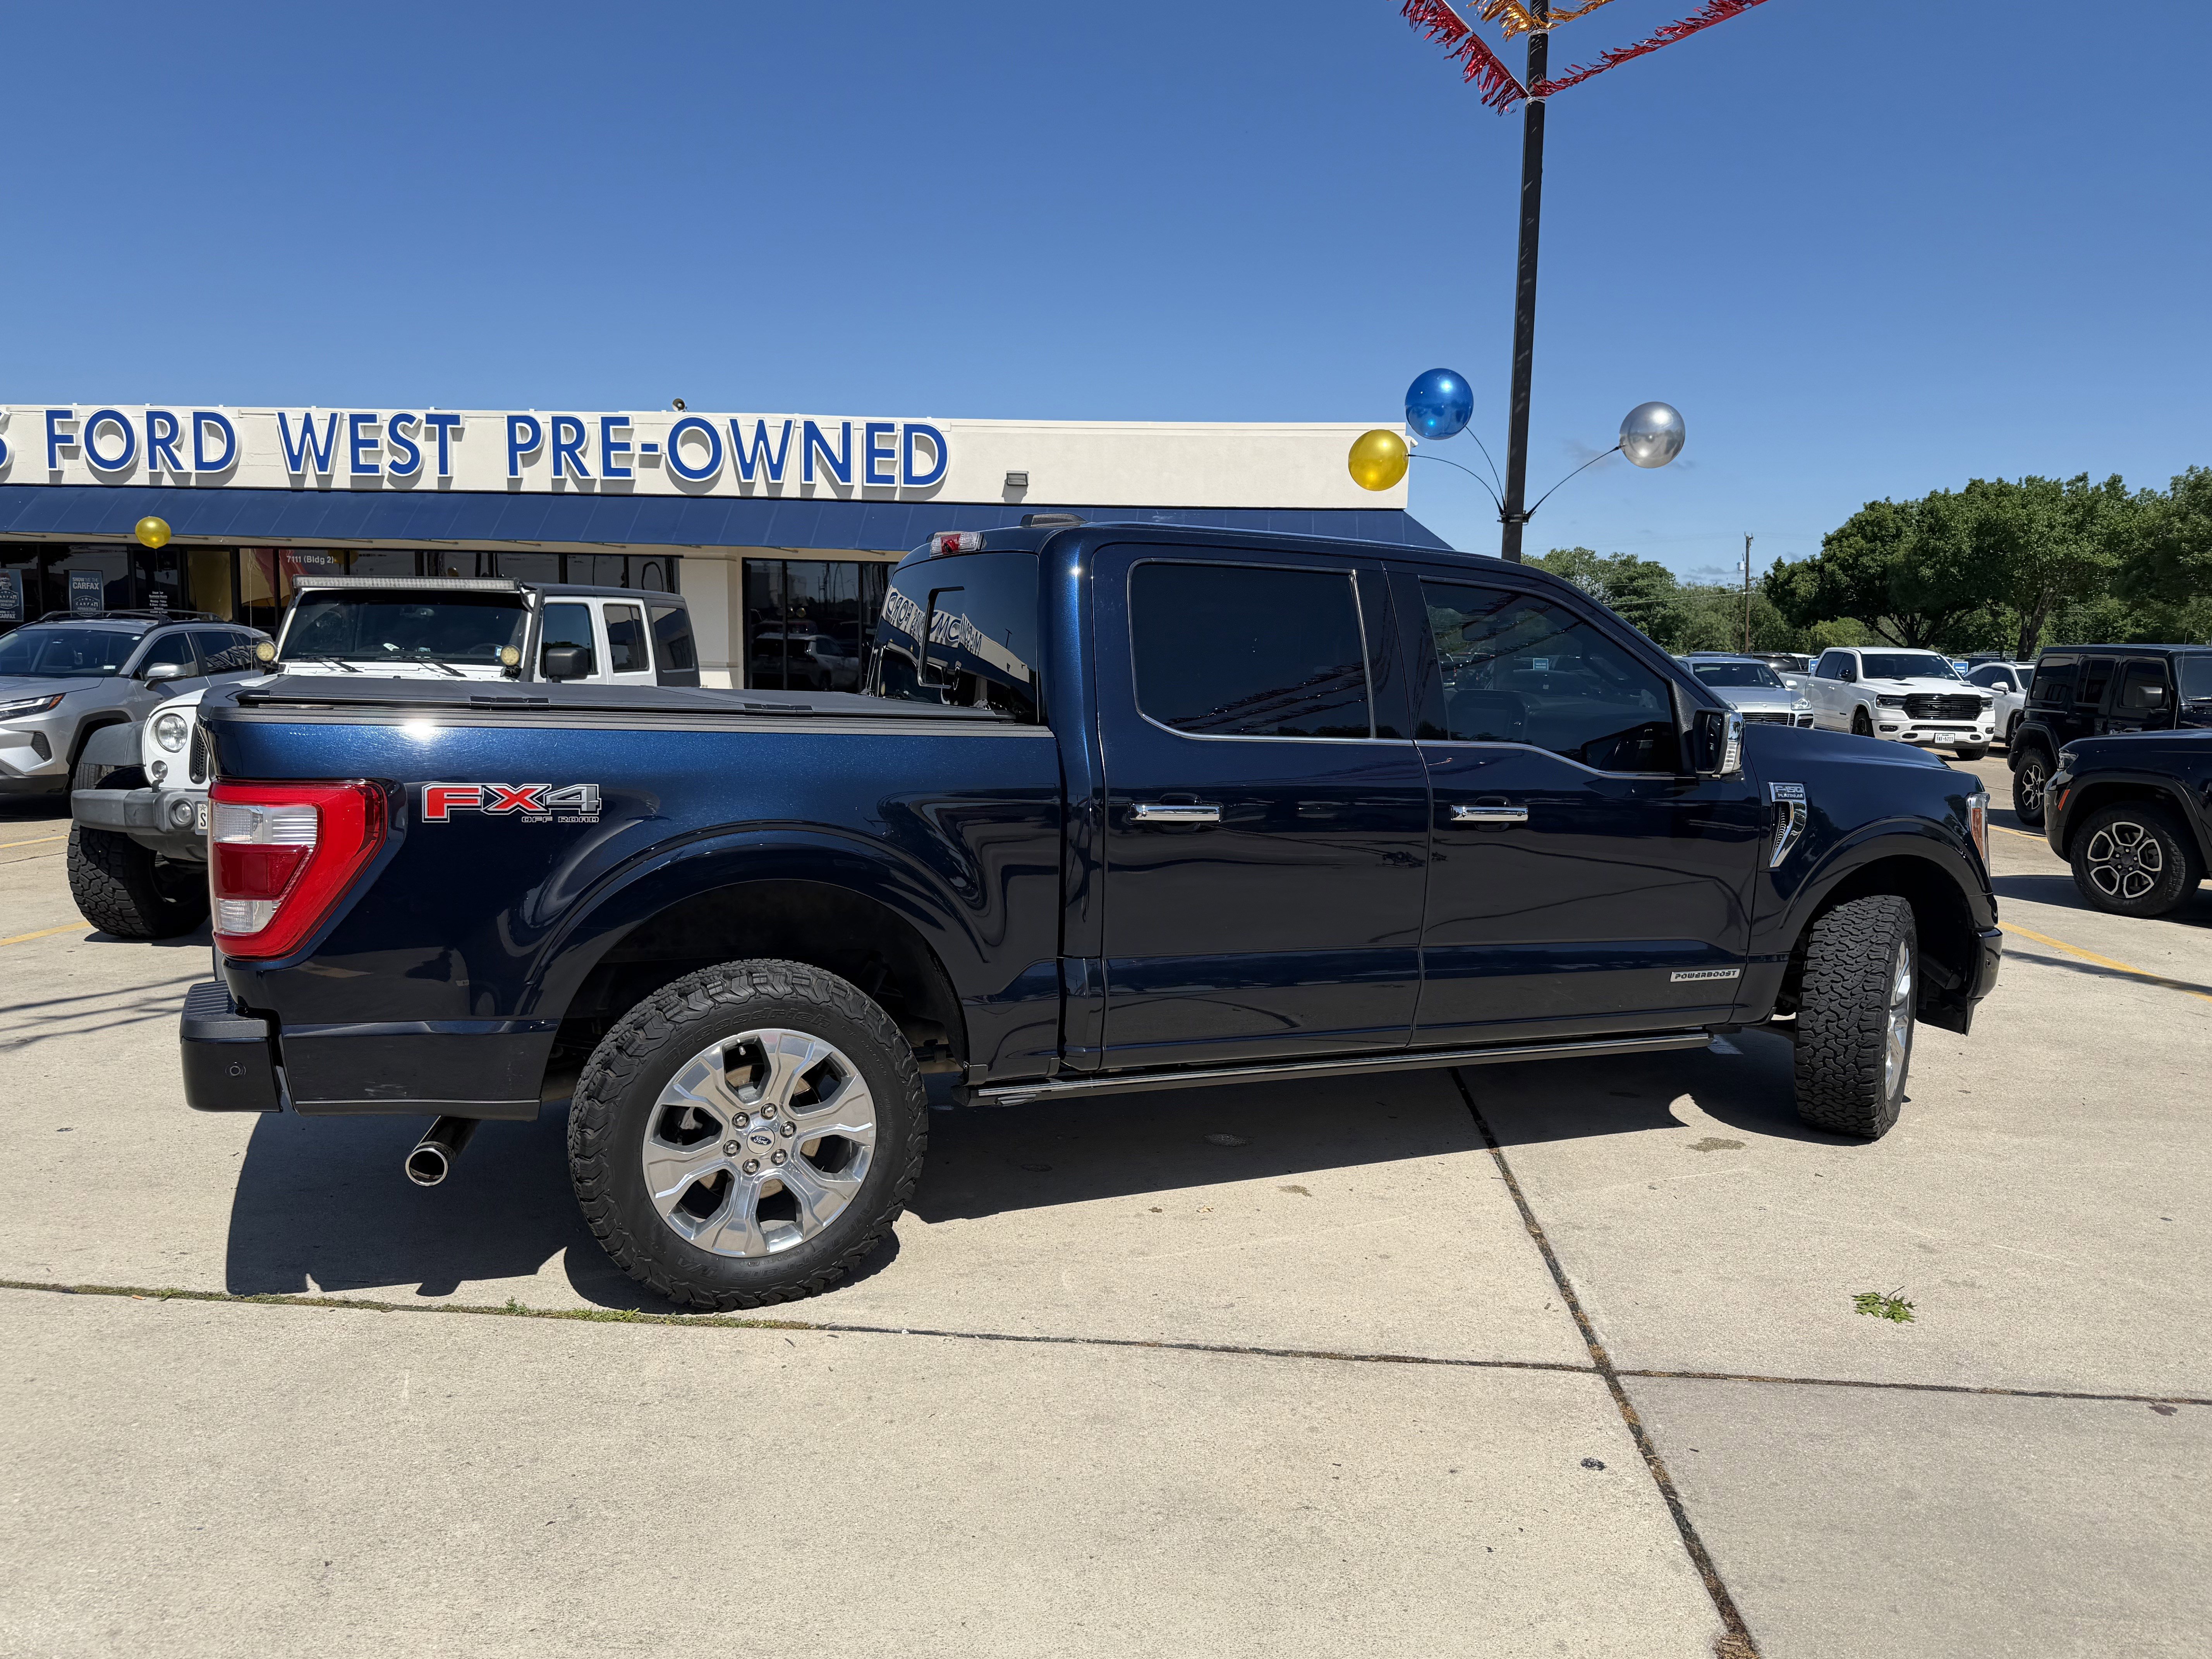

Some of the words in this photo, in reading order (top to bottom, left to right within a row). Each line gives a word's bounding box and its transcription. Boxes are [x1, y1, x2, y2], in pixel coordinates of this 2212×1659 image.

[44, 408, 239, 473] FORD
[276, 411, 462, 477] WEST
[505, 414, 950, 488] PRE-OWNED
[304, 556, 325, 565] (Bldg
[327, 556, 334, 564] 2)
[422, 783, 601, 823] FX4
[1675, 970, 1736, 979] POWERBOOST
[661, 1007, 832, 1069] BFGoodrich
[754, 1136, 769, 1144] Ford
